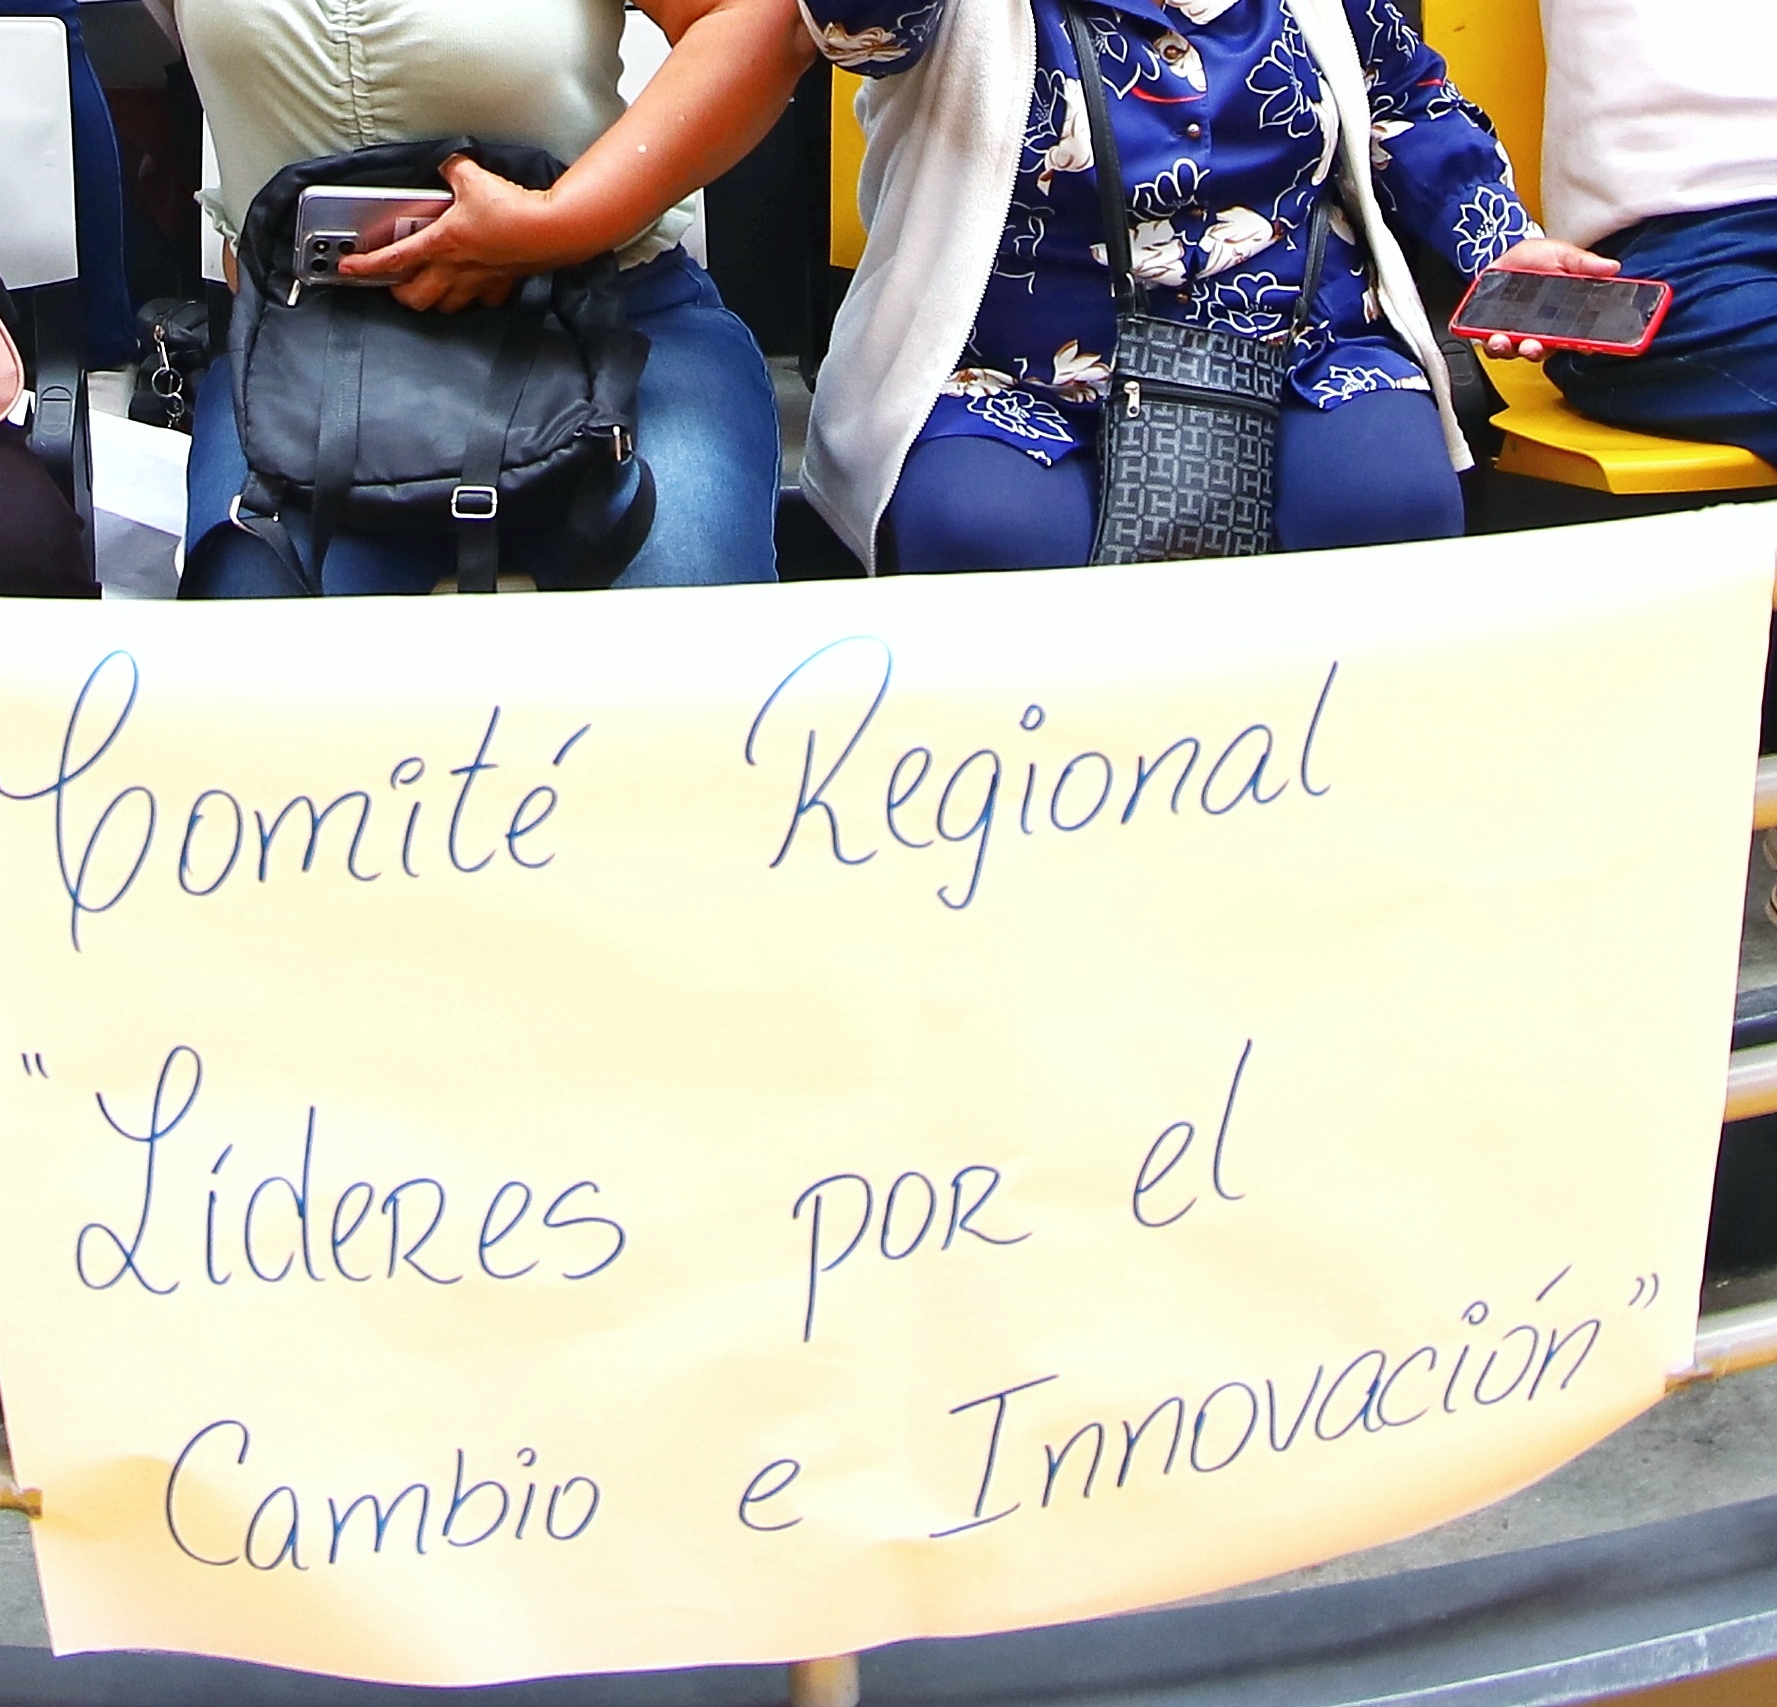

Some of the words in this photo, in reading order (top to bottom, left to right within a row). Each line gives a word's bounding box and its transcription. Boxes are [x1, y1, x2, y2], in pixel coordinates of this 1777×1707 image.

[743, 630, 1339, 912] Regional
[1129, 1036, 1254, 1228] el
[164, 1416, 603, 1574] Cambio
[737, 1452, 805, 1536] e
